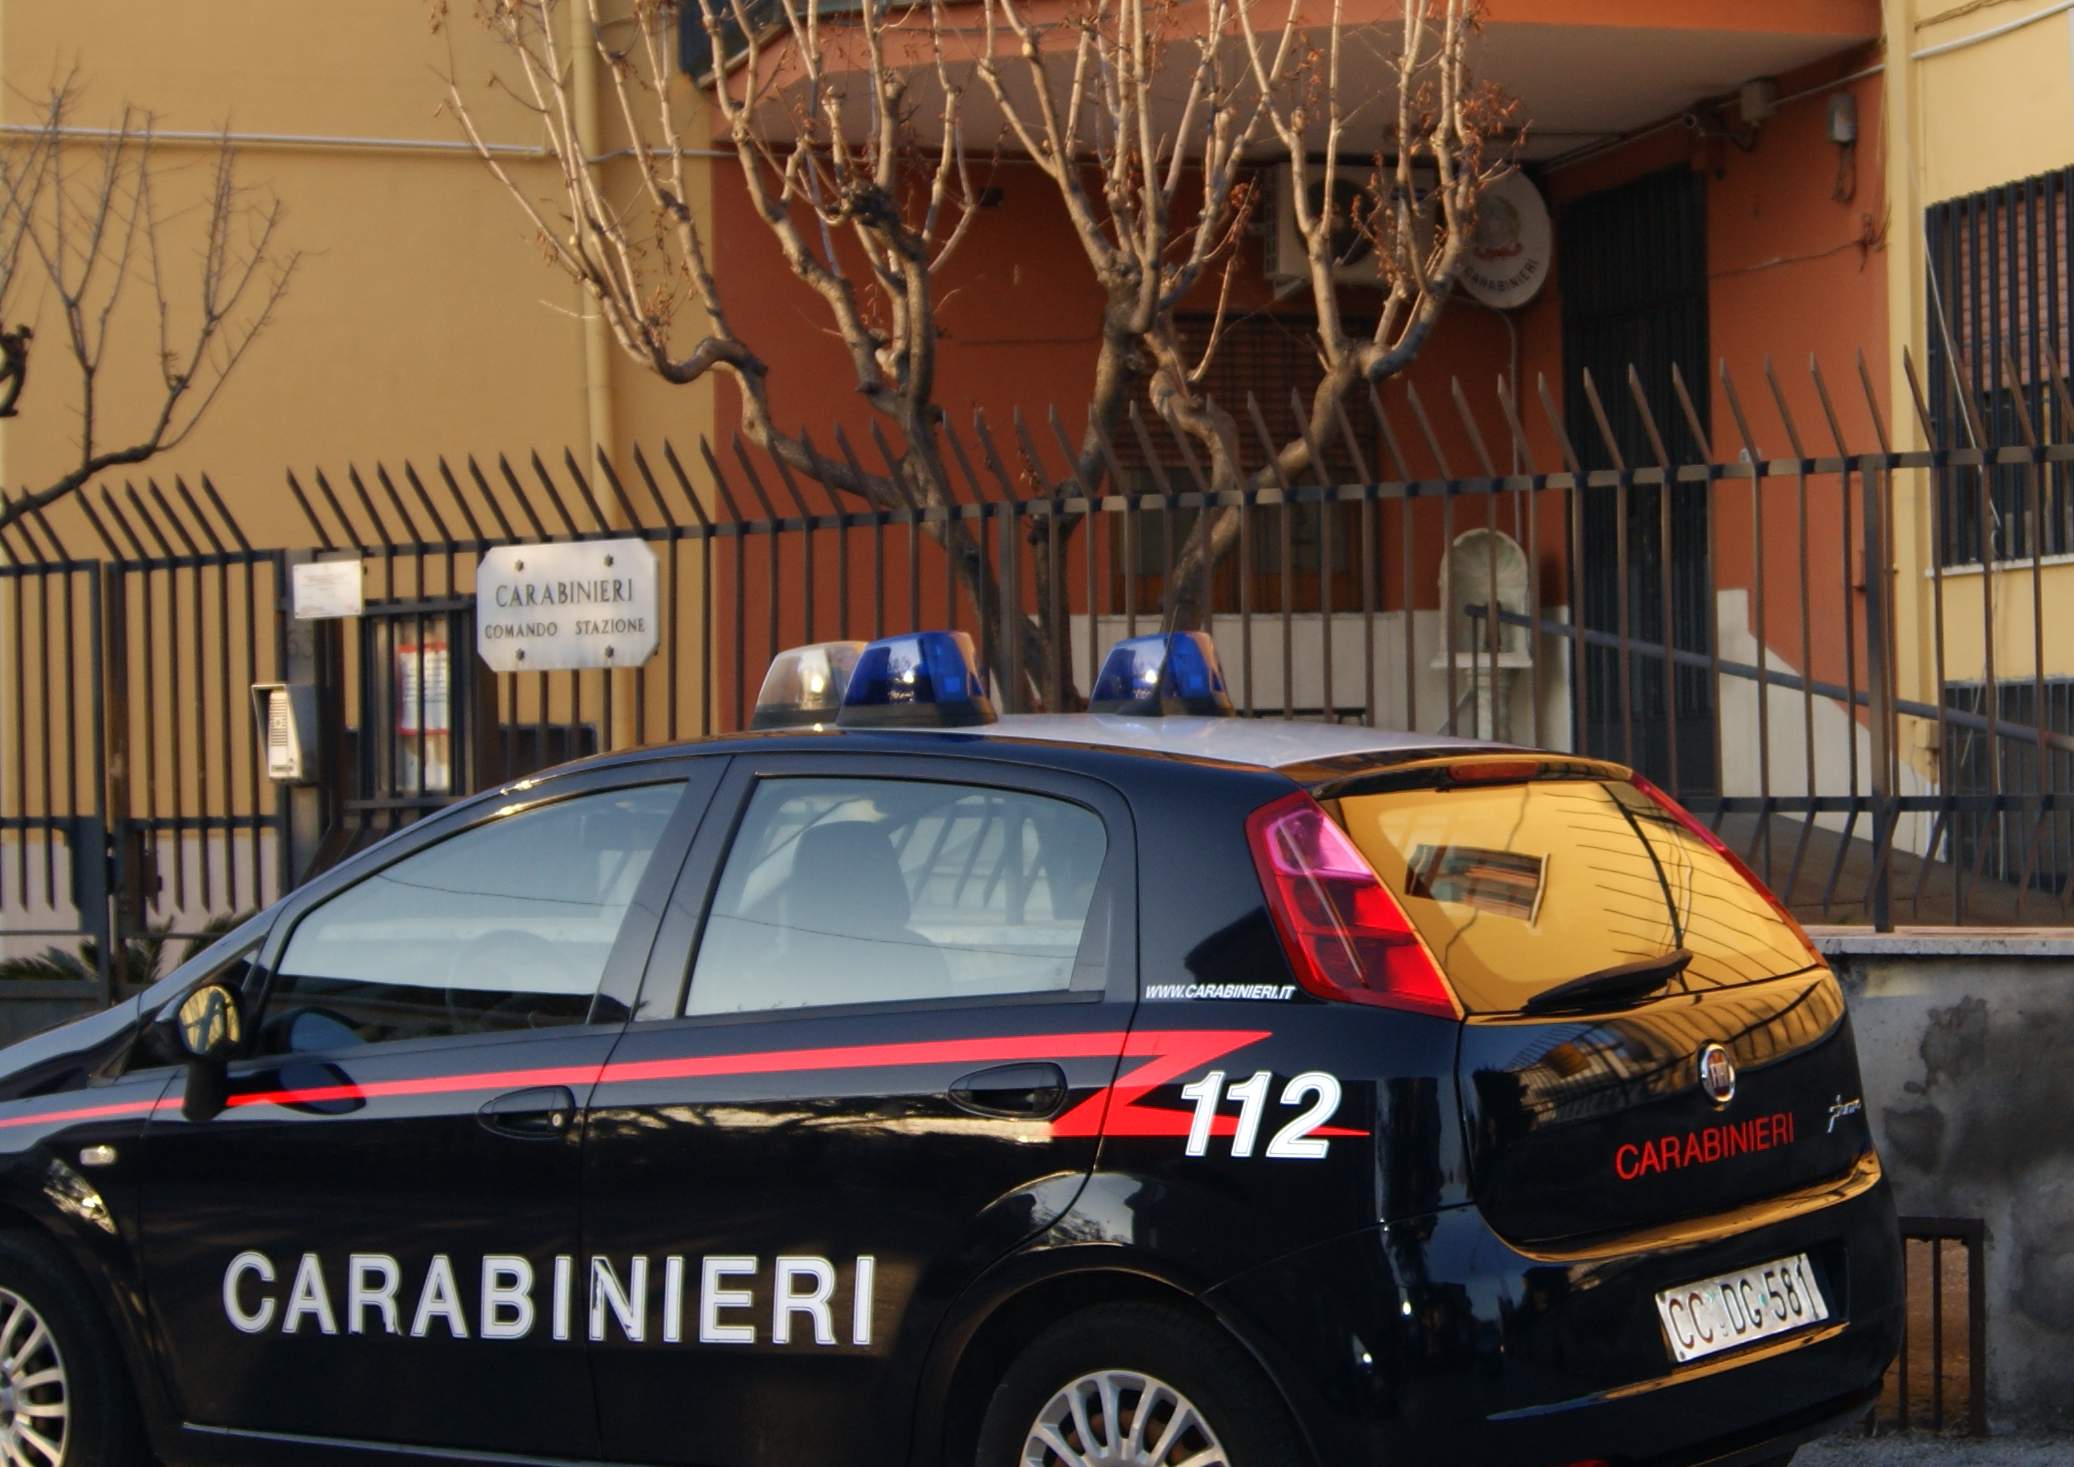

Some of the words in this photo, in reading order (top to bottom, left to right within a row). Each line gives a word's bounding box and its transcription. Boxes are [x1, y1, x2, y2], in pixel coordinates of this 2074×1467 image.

[495, 578, 633, 608] CARABINIERI
[484, 622, 558, 640] COMANDO
[575, 617, 645, 635] STAZIONE
[1145, 984, 1296, 1000] WWW.CARABINIERI.IT
[1181, 1070, 1342, 1159] 112
[1615, 1112, 1795, 1181] CARABINIERI
[222, 1251, 875, 1346] CARABINIERI
